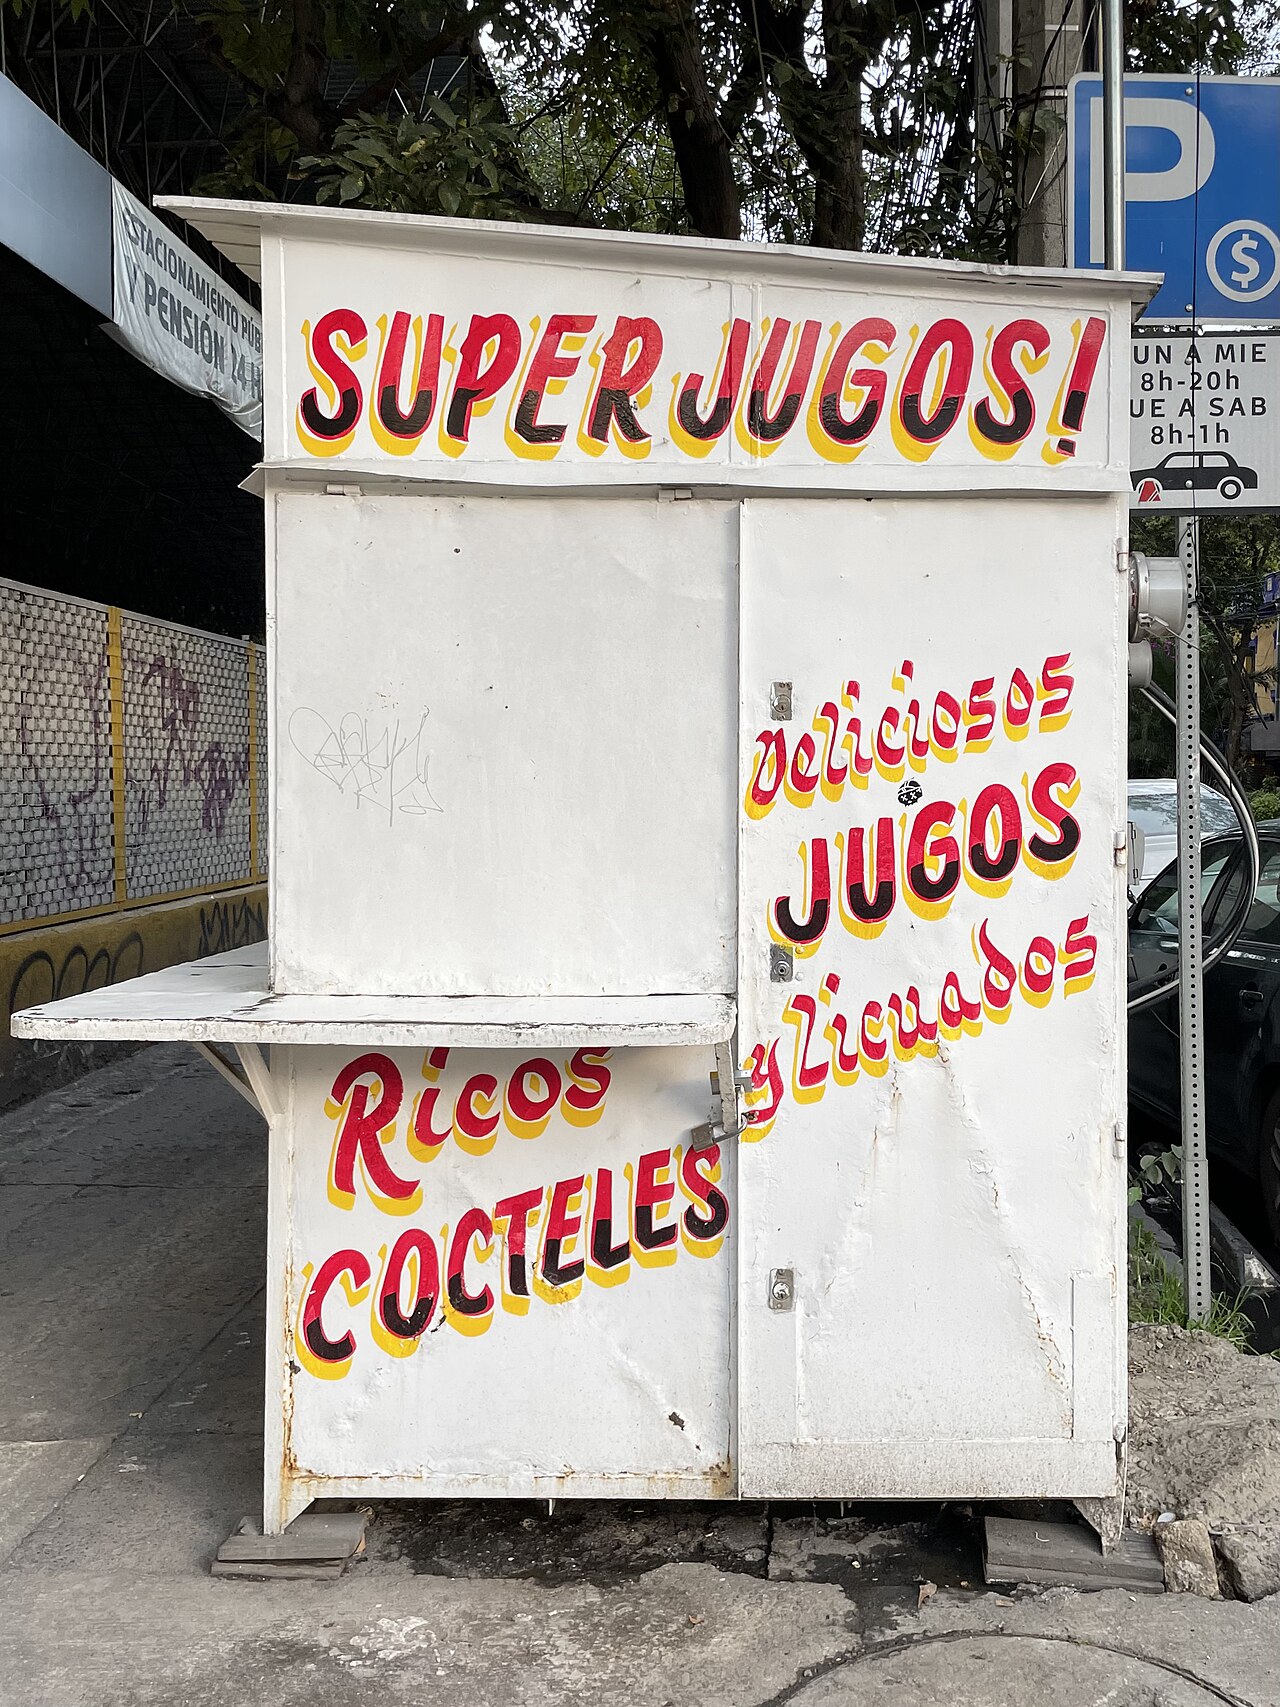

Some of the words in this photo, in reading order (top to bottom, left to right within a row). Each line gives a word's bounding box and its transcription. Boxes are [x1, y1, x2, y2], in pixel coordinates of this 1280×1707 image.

[1090, 96, 1216, 264] P
[123, 207, 239, 333] ESTACIONAMIENTO
[241, 316, 262, 354] PÚB
[124, 254, 140, 305] Y
[144, 271, 225, 375] PENSIÓN
[231, 342, 247, 392] 24
[1133, 344, 1172, 365] UN
[1184, 344, 1202, 365] A
[1215, 343, 1267, 364] MIE
[299, 308, 655, 448] SUPER
[674, 316, 1107, 458] JUGOS!
[1130, 398, 1166, 418] UE
[1178, 398, 1196, 418] A
[1209, 397, 1267, 417] SAB
[1140, 369, 1240, 392] 8h-20h
[1150, 422, 1230, 445] 8h-1h
[748, 652, 1075, 812] Deliciosos
[771, 762, 1082, 950] JUGOS
[329, 1047, 613, 1204] Ricos
[745, 1035, 785, 1130] y
[300, 1143, 730, 1368] COCTELES
